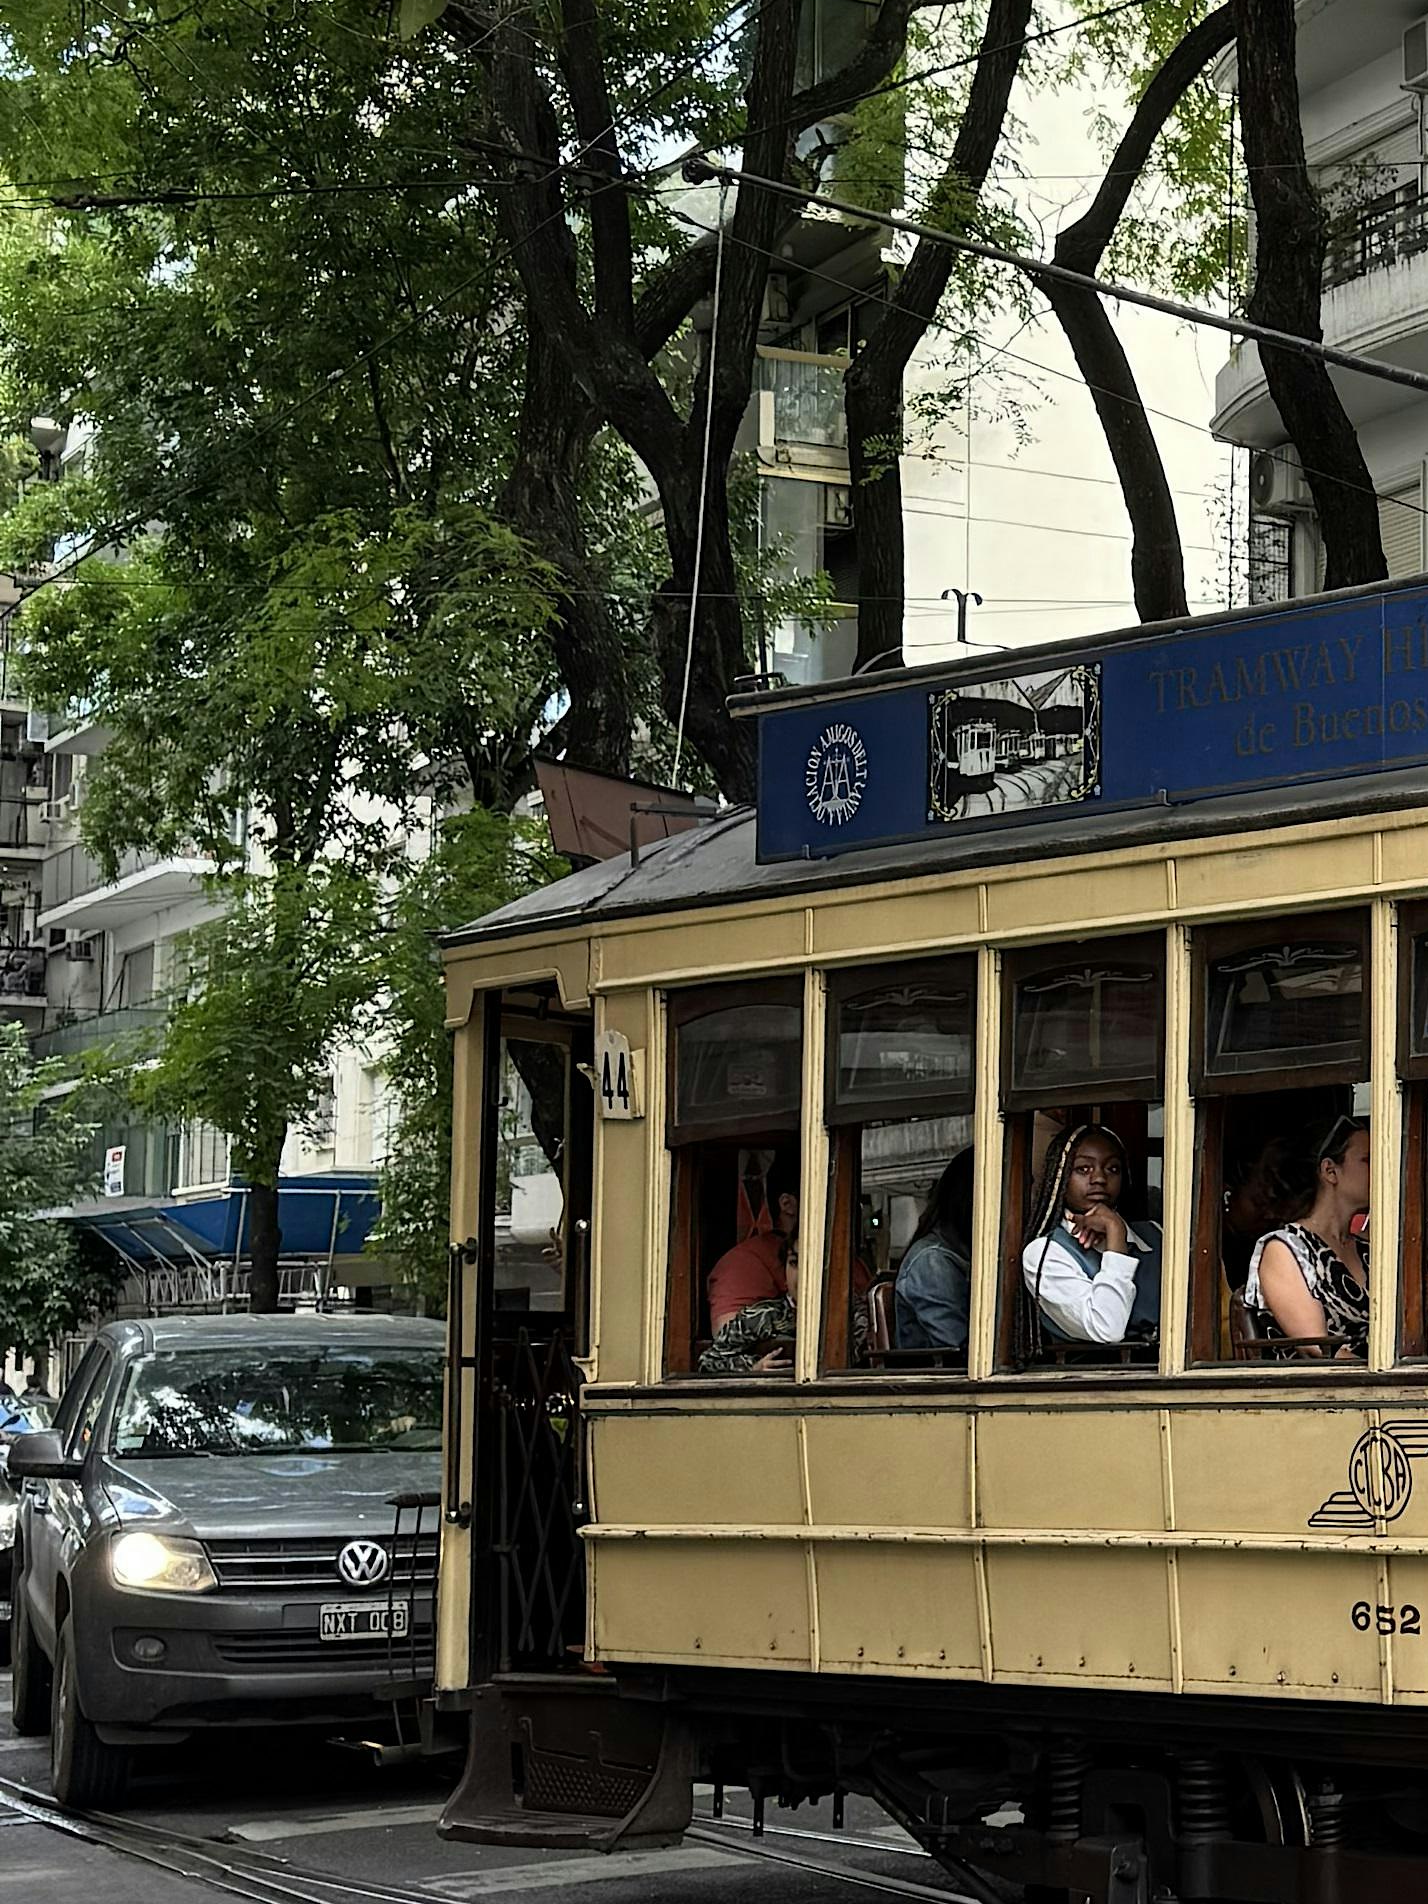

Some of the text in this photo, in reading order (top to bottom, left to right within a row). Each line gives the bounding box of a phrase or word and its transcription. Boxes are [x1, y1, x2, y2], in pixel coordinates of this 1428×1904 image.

[1149, 636, 1364, 713] TRAMWAY
[1235, 712, 1274, 758] de
[1291, 698, 1428, 748] Buenos
[602, 1050, 630, 1110] 44
[323, 1611, 358, 1634] NXT
[1351, 1600, 1421, 1636] 652
